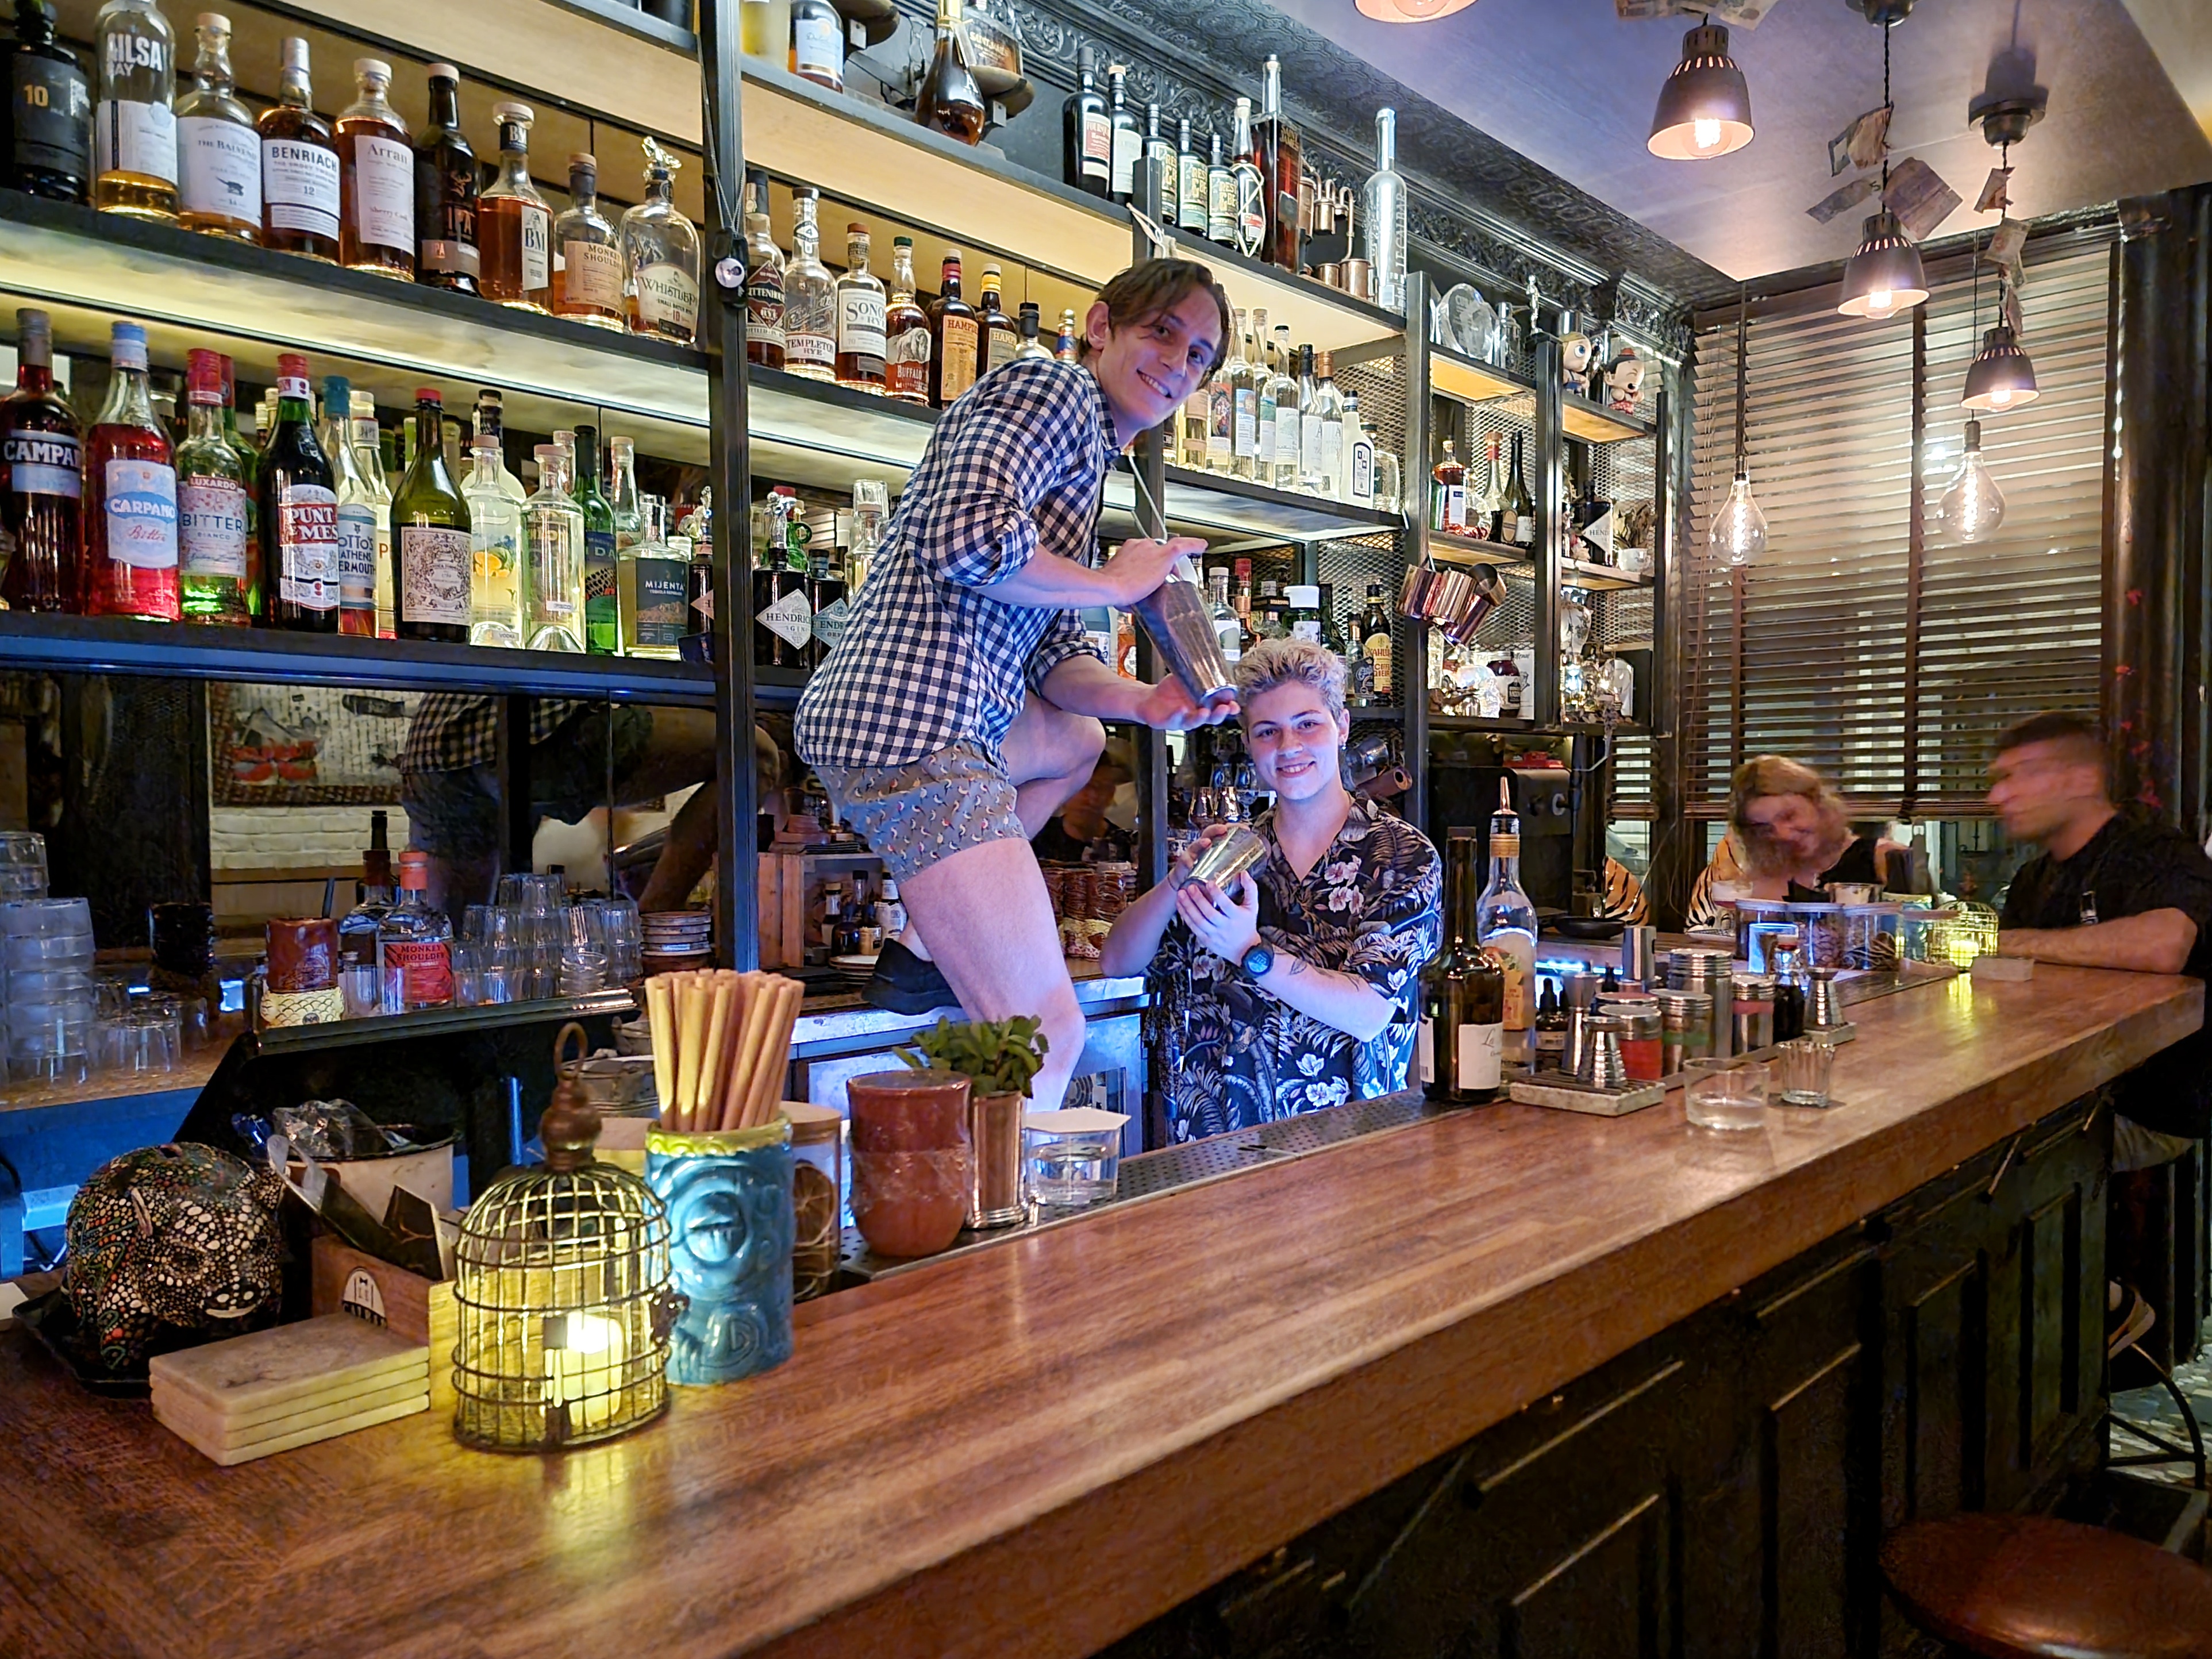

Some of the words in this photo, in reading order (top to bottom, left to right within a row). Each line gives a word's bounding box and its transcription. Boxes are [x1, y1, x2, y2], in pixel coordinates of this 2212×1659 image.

[24, 84, 49, 107] 10
[508, 124, 528, 145] BM
[272, 147, 337, 172] BENRIACH
[367, 144, 408, 165] Arran
[303, 186, 315, 196] 12
[524, 228, 546, 252] BM
[748, 286, 786, 305] ITTENHOU
[672, 310, 681, 322] 10
[804, 347, 822, 356] RYE
[897, 364, 923, 380] BUFFALO
[190, 477, 237, 490] LUXARDO
[110, 498, 175, 519] CARPANO
[288, 507, 333, 524] PUNT
[182, 514, 243, 533] BITTER
[197, 532, 231, 541] BIANCO
[298, 524, 338, 541] MES
[585, 546, 616, 561] IDA
[338, 561, 377, 575] ERMOUTH
[645, 580, 684, 591] MIJENTA
[401, 944, 442, 953] MONKEY
